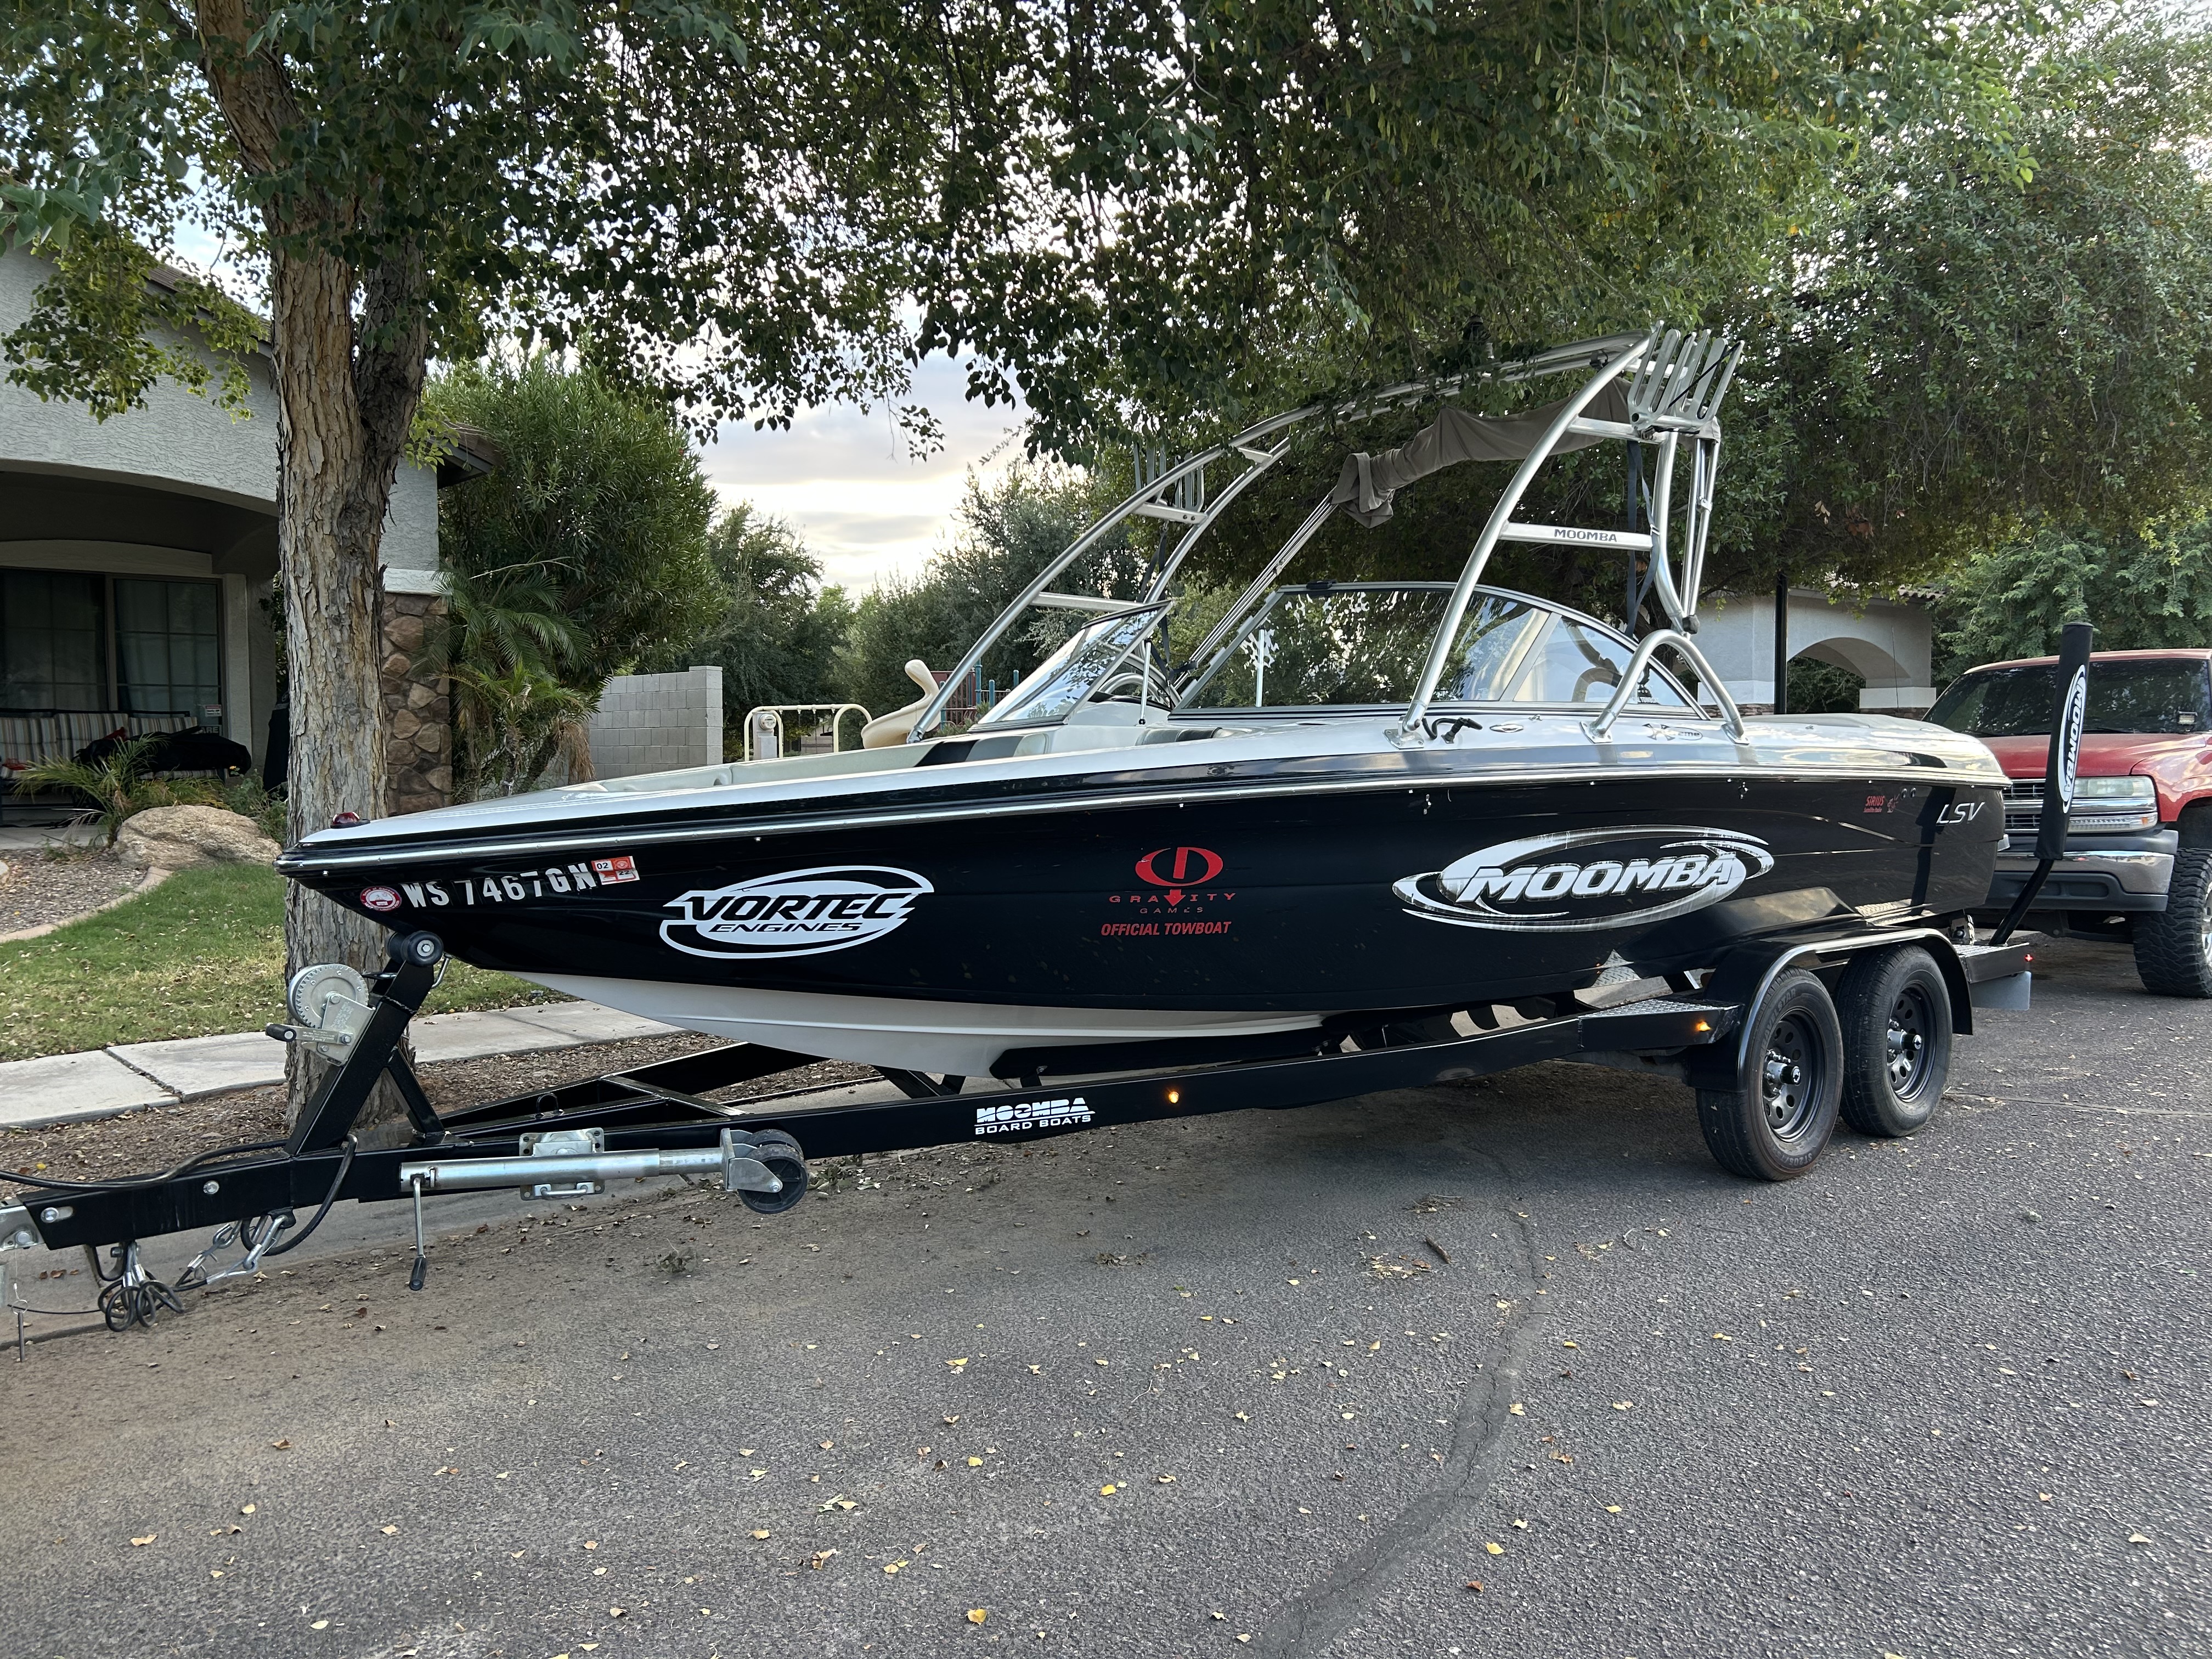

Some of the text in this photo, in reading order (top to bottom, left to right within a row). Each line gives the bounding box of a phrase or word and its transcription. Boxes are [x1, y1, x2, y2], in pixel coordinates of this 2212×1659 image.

[1554, 529, 1617, 542] MOOMBA
[2064, 683, 2084, 792] MOOMBA
[1865, 795, 1885, 806] SIRIUS
[1936, 802, 1985, 826] LSV
[1454, 851, 1737, 905] MOOMBA
[399, 881, 450, 908] WS
[681, 893, 917, 921] VORTEC
[708, 922, 863, 933] ENGINES
[1101, 921, 1232, 936] OFFICIAL TOWBOAT
[977, 1097, 1089, 1123] MOOMBA
[975, 1115, 1091, 1135] BOARD BOATS
